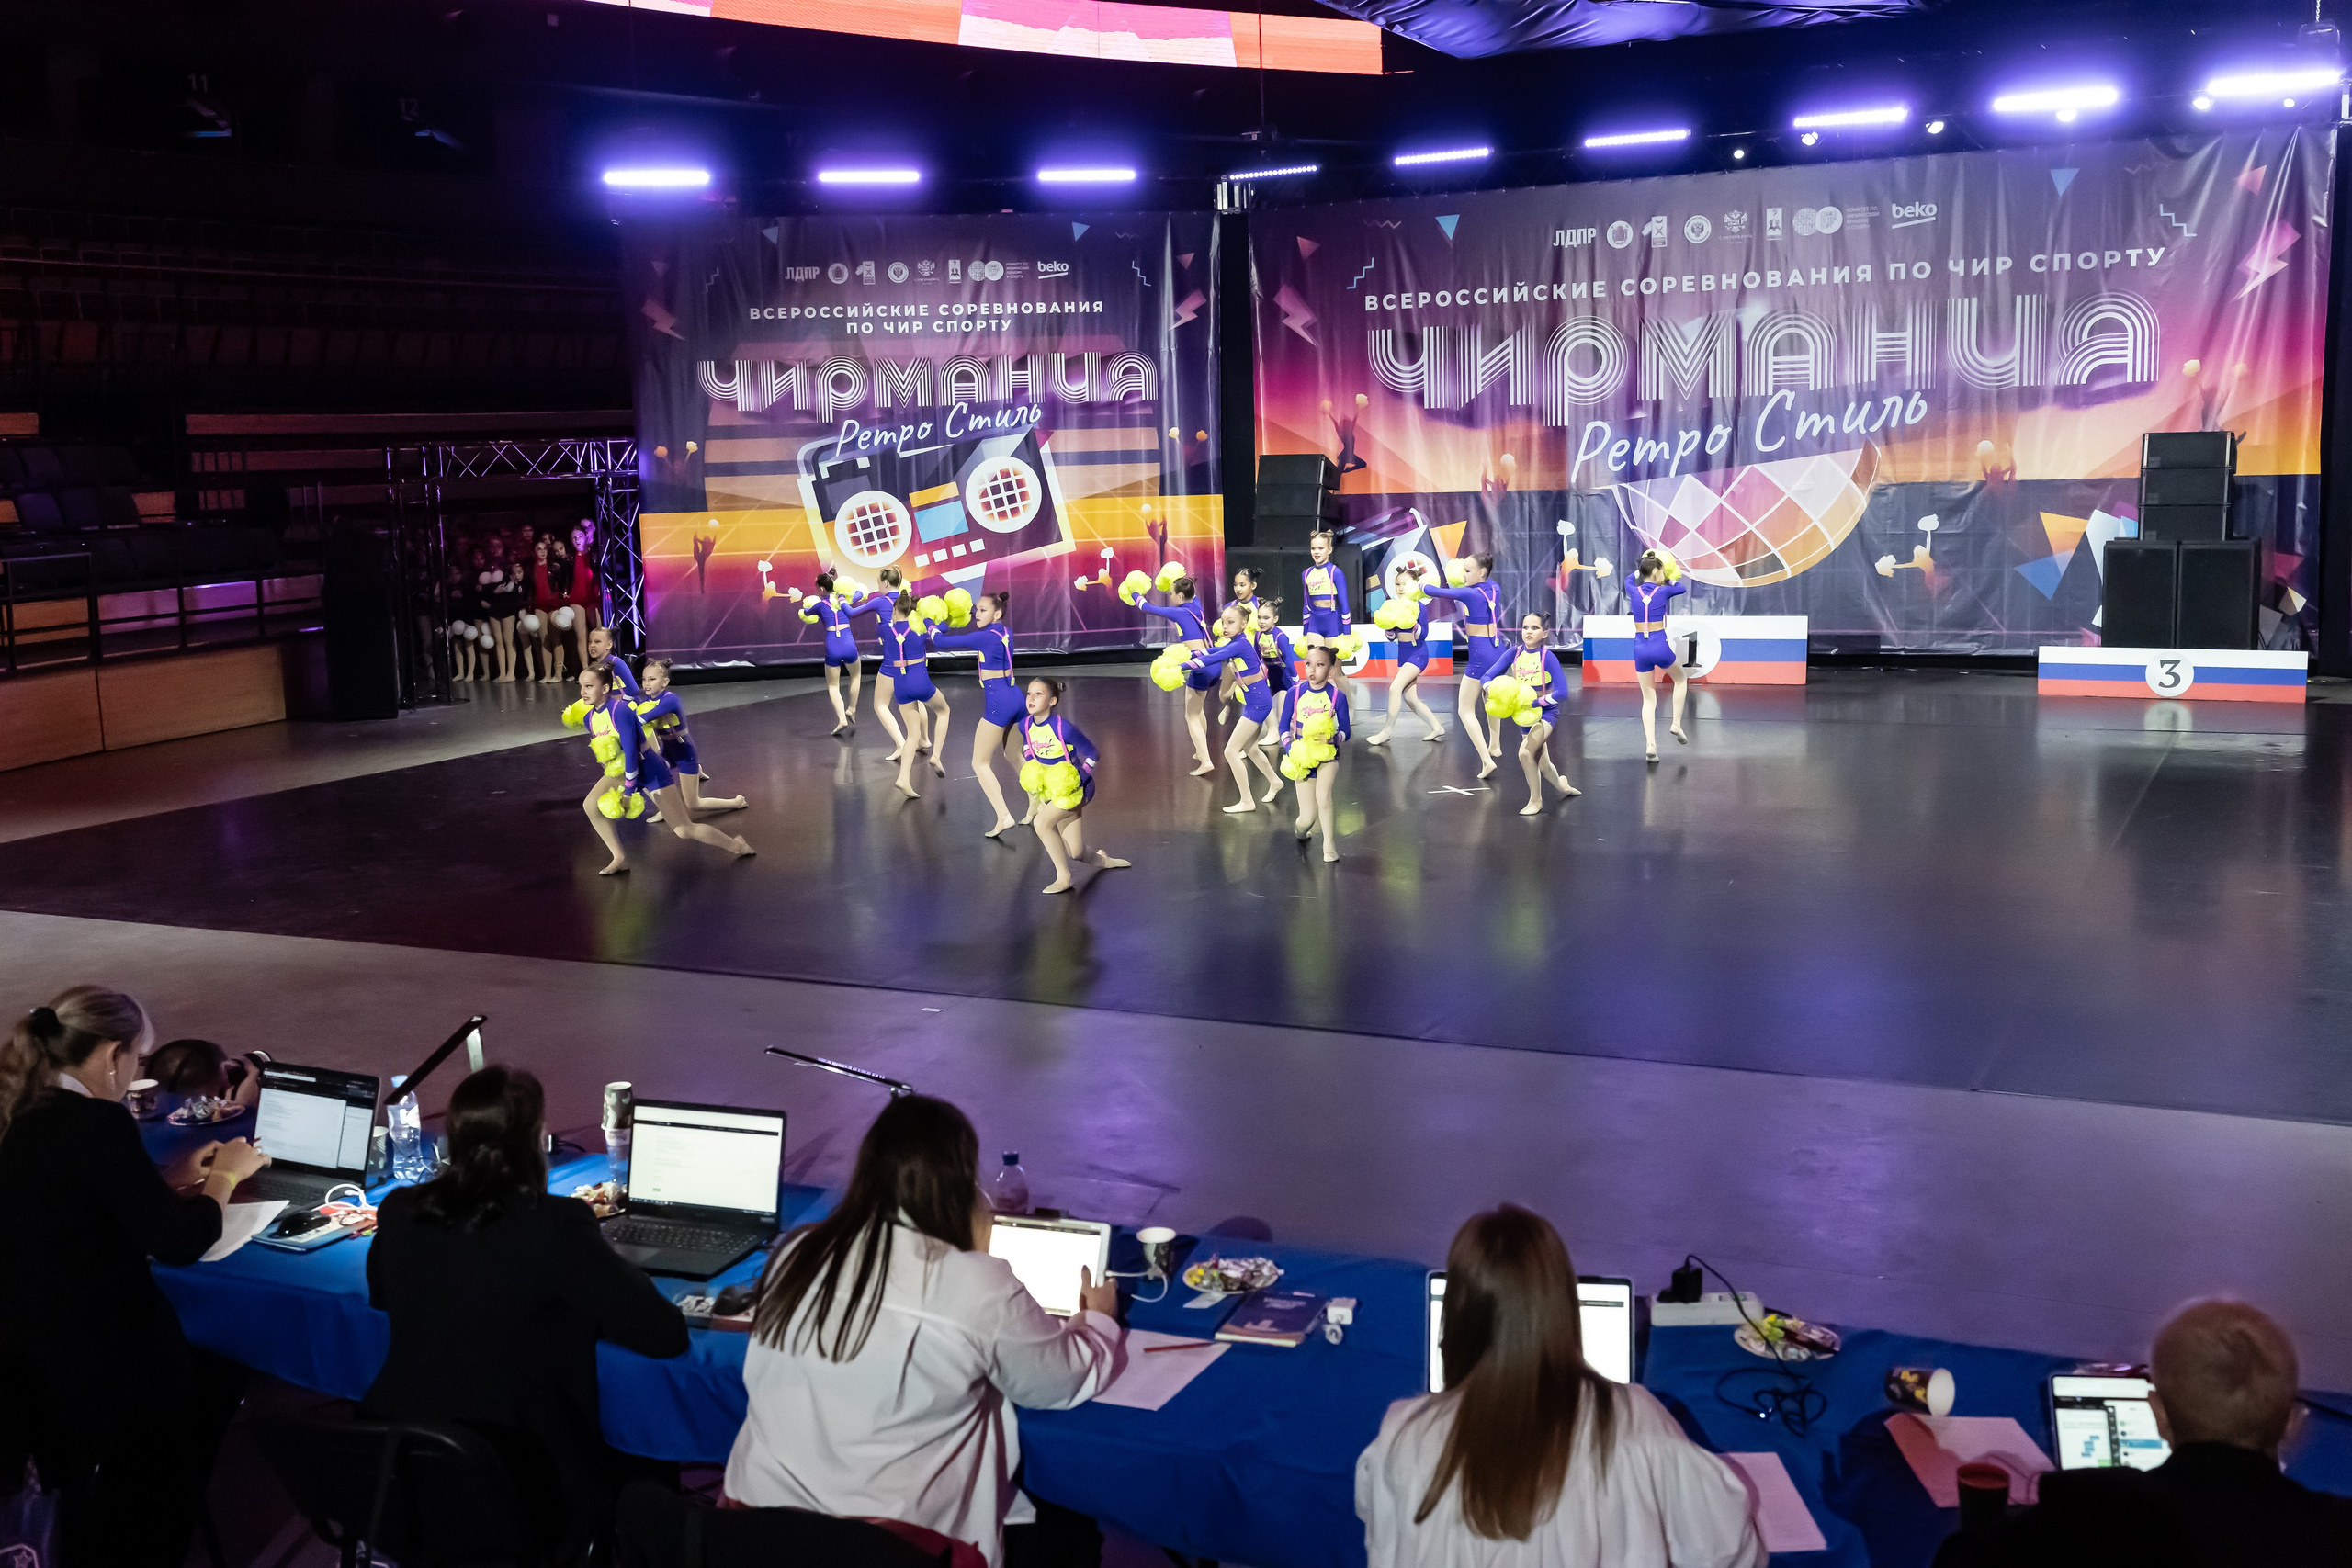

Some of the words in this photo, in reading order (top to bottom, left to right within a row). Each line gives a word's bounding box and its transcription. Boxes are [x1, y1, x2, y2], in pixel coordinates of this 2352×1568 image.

[187, 72, 209, 93] 11
[1892, 201, 1938, 219] beko
[1553, 227, 1597, 248] ЛДПР
[785, 266, 820, 282] ЛДПР
[1037, 260, 1069, 273] beko
[1364, 280, 1606, 311] ВСЕРОССИЙСКИЕ
[1620, 265, 1871, 296] СОРЕВНОВАНИЯ
[1889, 261, 1932, 280] ПО
[1949, 256, 2013, 277] ЧИР
[2029, 246, 2166, 274] СПОРТУ
[749, 302, 929, 320] ВСЕРОССИЙСКИЕ
[938, 301, 1104, 317] СОРЕВНОВАНИЯ
[846, 321, 875, 334] ПО
[884, 320, 923, 333] ЧИР
[933, 318, 1012, 333] СПОРТУ
[835, 419, 933, 457] Ретро
[945, 401, 1042, 439] Стиль
[1570, 420, 1733, 484] Ретро
[1754, 389, 1928, 453] Стиль
[1681, 630, 1702, 668] 1
[2157, 659, 2182, 689] 3
